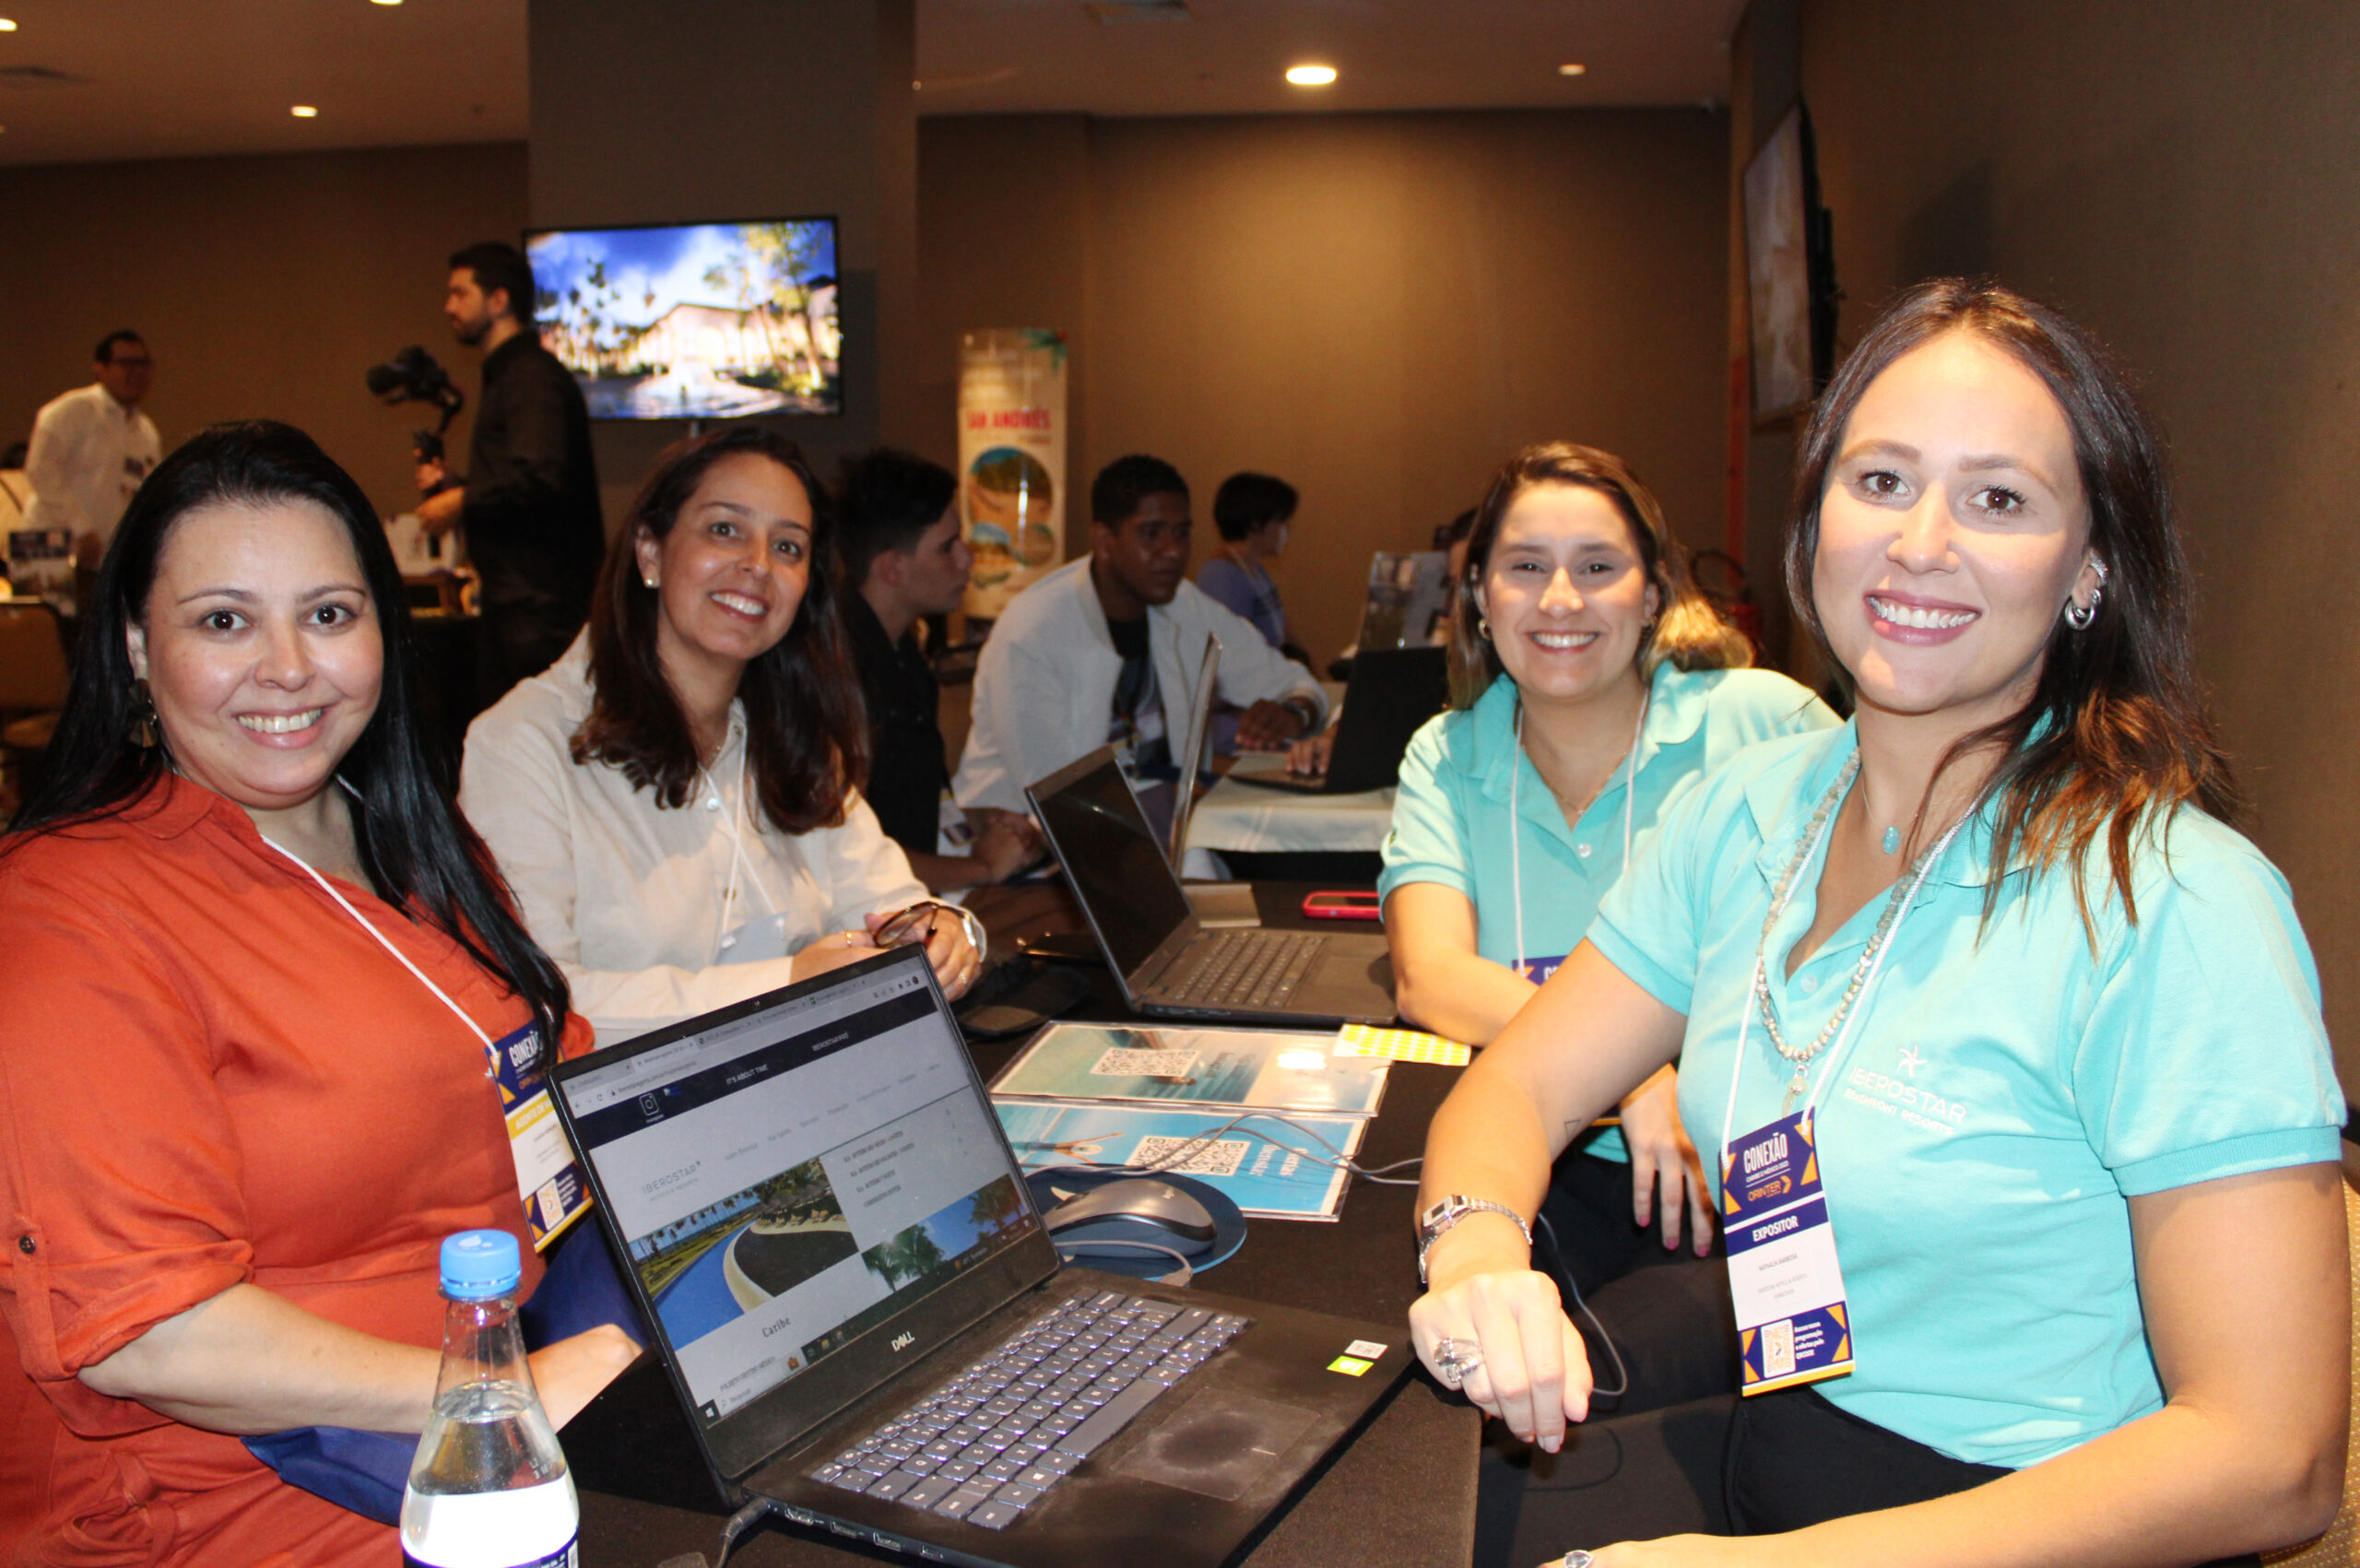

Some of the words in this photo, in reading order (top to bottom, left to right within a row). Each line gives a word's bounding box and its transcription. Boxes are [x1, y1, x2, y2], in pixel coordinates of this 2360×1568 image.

[1849, 1067, 1969, 1124] IBEROSTAR
[1743, 1132, 1788, 1173] CONEXÃO
[643, 1165, 696, 1195] IBEROSTAR
[1752, 1215, 1799, 1243] EXPOSITOR
[762, 1316, 791, 1338] Caribe
[891, 1331, 915, 1351] DELL
